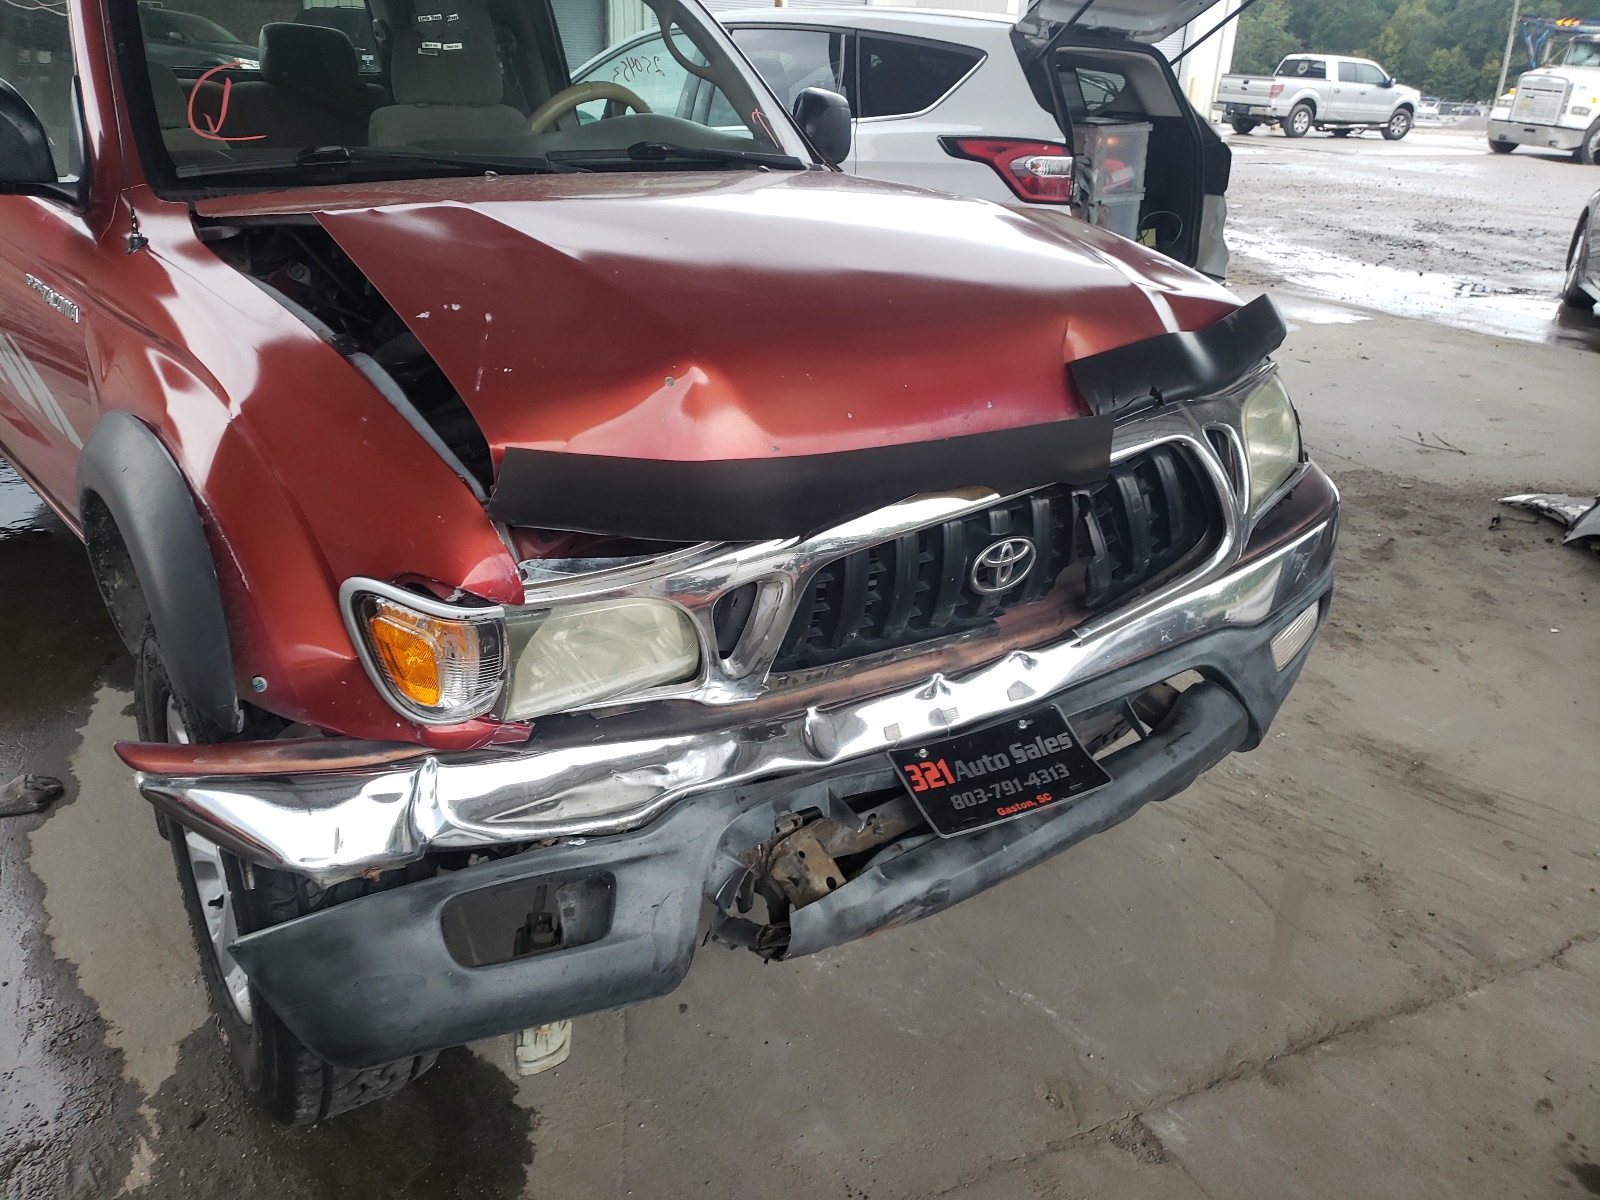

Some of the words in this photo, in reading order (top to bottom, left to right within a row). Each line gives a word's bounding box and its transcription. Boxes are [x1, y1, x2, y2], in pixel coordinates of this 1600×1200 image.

[904, 758, 956, 792] 321
[954, 750, 1011, 782] Auto
[1009, 732, 1073, 764] Sales
[950, 762, 1070, 810] 803-791-4313
[996, 799, 1038, 816] Gaston,
[1036, 792, 1053, 805] SC
